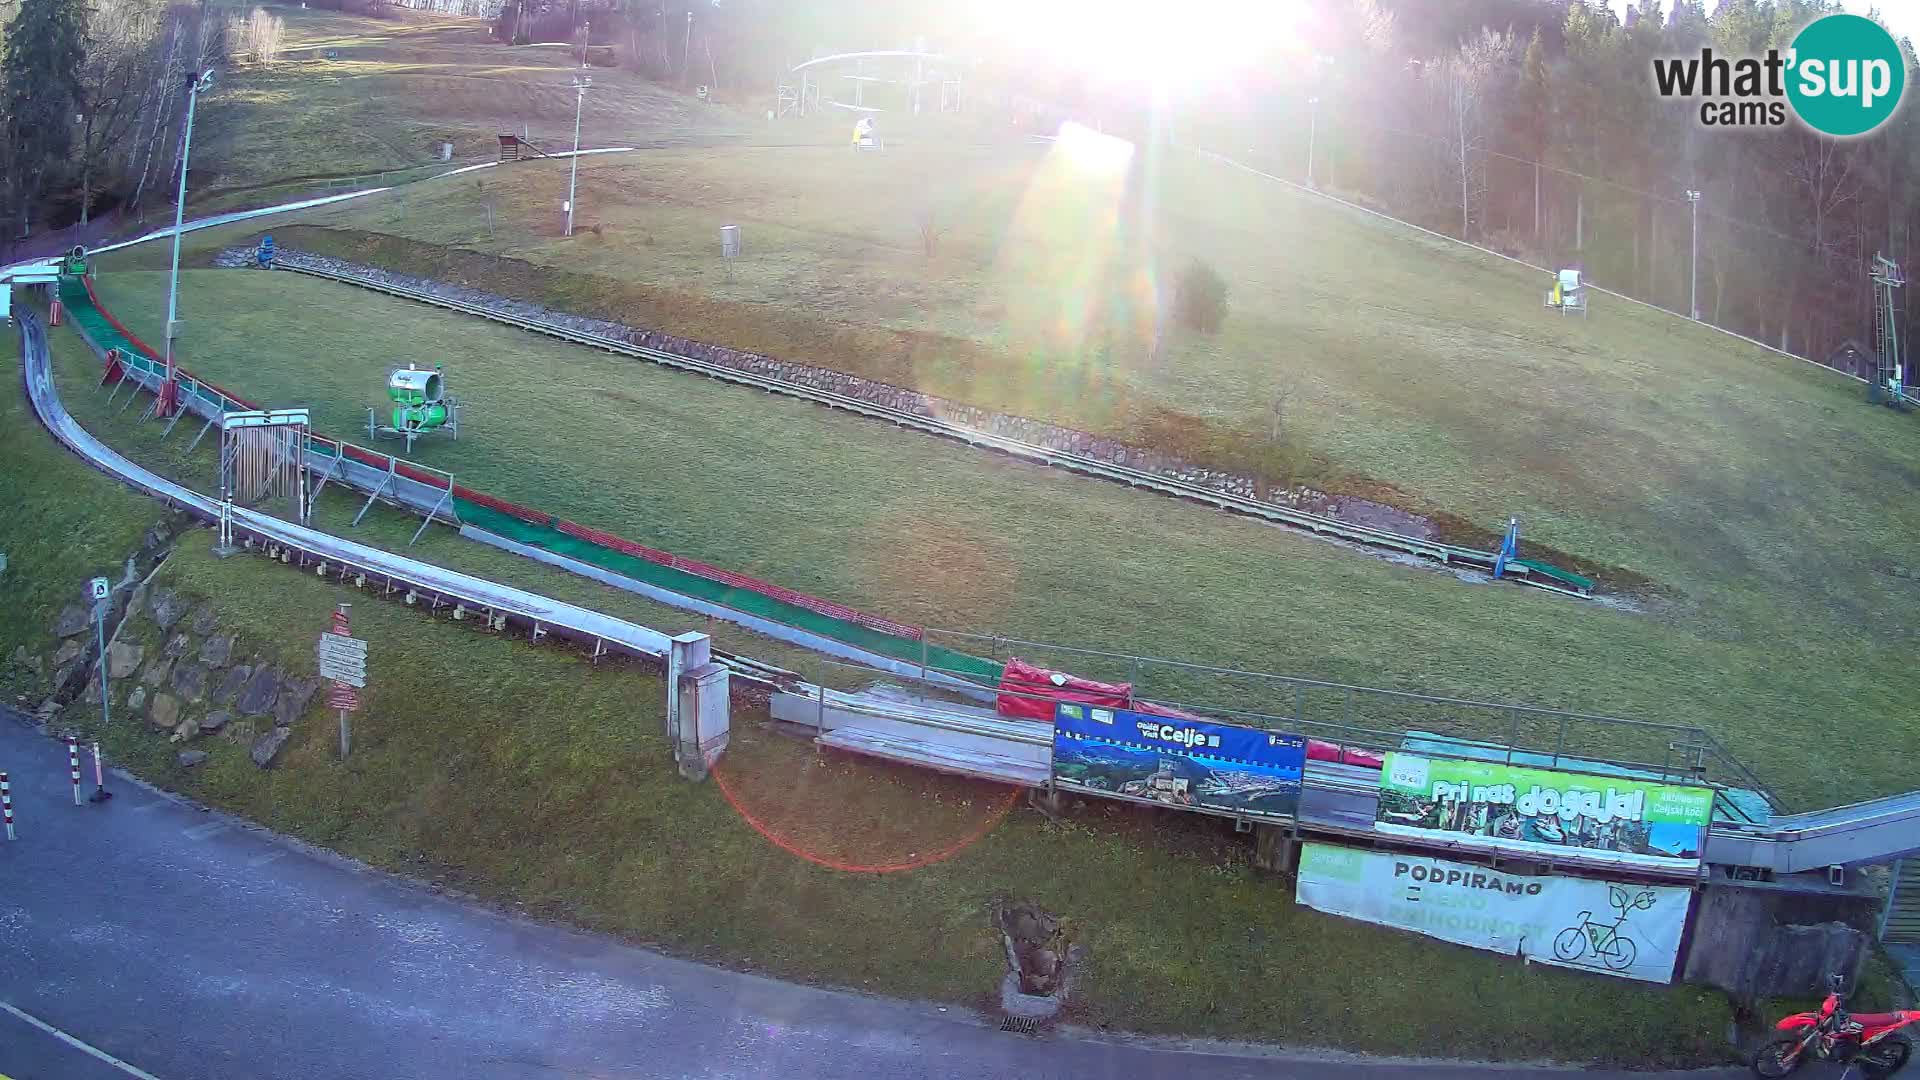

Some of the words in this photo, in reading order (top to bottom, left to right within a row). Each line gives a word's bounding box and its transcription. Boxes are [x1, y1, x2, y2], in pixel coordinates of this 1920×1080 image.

[1160, 725, 1206, 748] Celje
[1431, 779, 1469, 803] Pri
[1472, 782, 1517, 805] nas
[1516, 784, 1644, 824] dogaja!
[1393, 861, 1543, 896] PODPIRAMO
